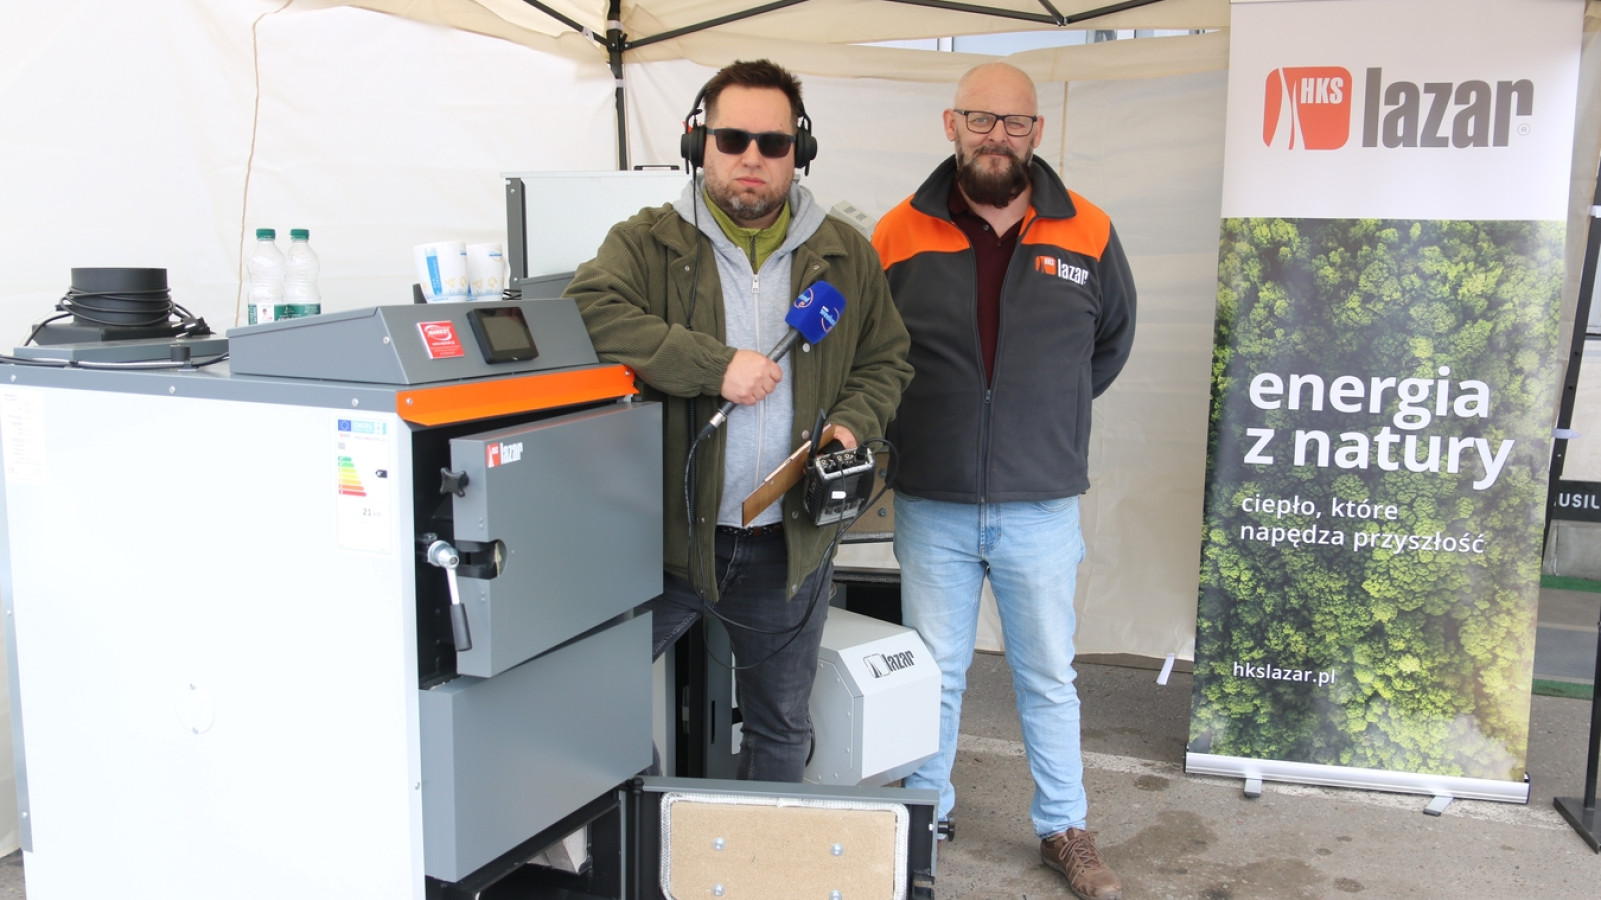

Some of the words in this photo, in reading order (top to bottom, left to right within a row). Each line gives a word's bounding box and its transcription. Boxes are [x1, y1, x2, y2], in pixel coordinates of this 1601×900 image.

[1300, 76, 1344, 104] HKS
[1362, 67, 1534, 149] lazar
[1057, 258, 1089, 285] lazar
[1249, 366, 1490, 430] energia
[499, 441, 524, 465] lazar
[1243, 428, 1275, 465] z
[1294, 426, 1515, 491] natury
[1241, 494, 1322, 519] ciepło,
[1331, 497, 1399, 520] które
[1553, 492, 1600, 510] USIL
[1240, 524, 1345, 549] napędza
[1353, 528, 1486, 555] przyszłość
[881, 650, 915, 672] lazar
[1233, 661, 1337, 685] hkslazar.pl
